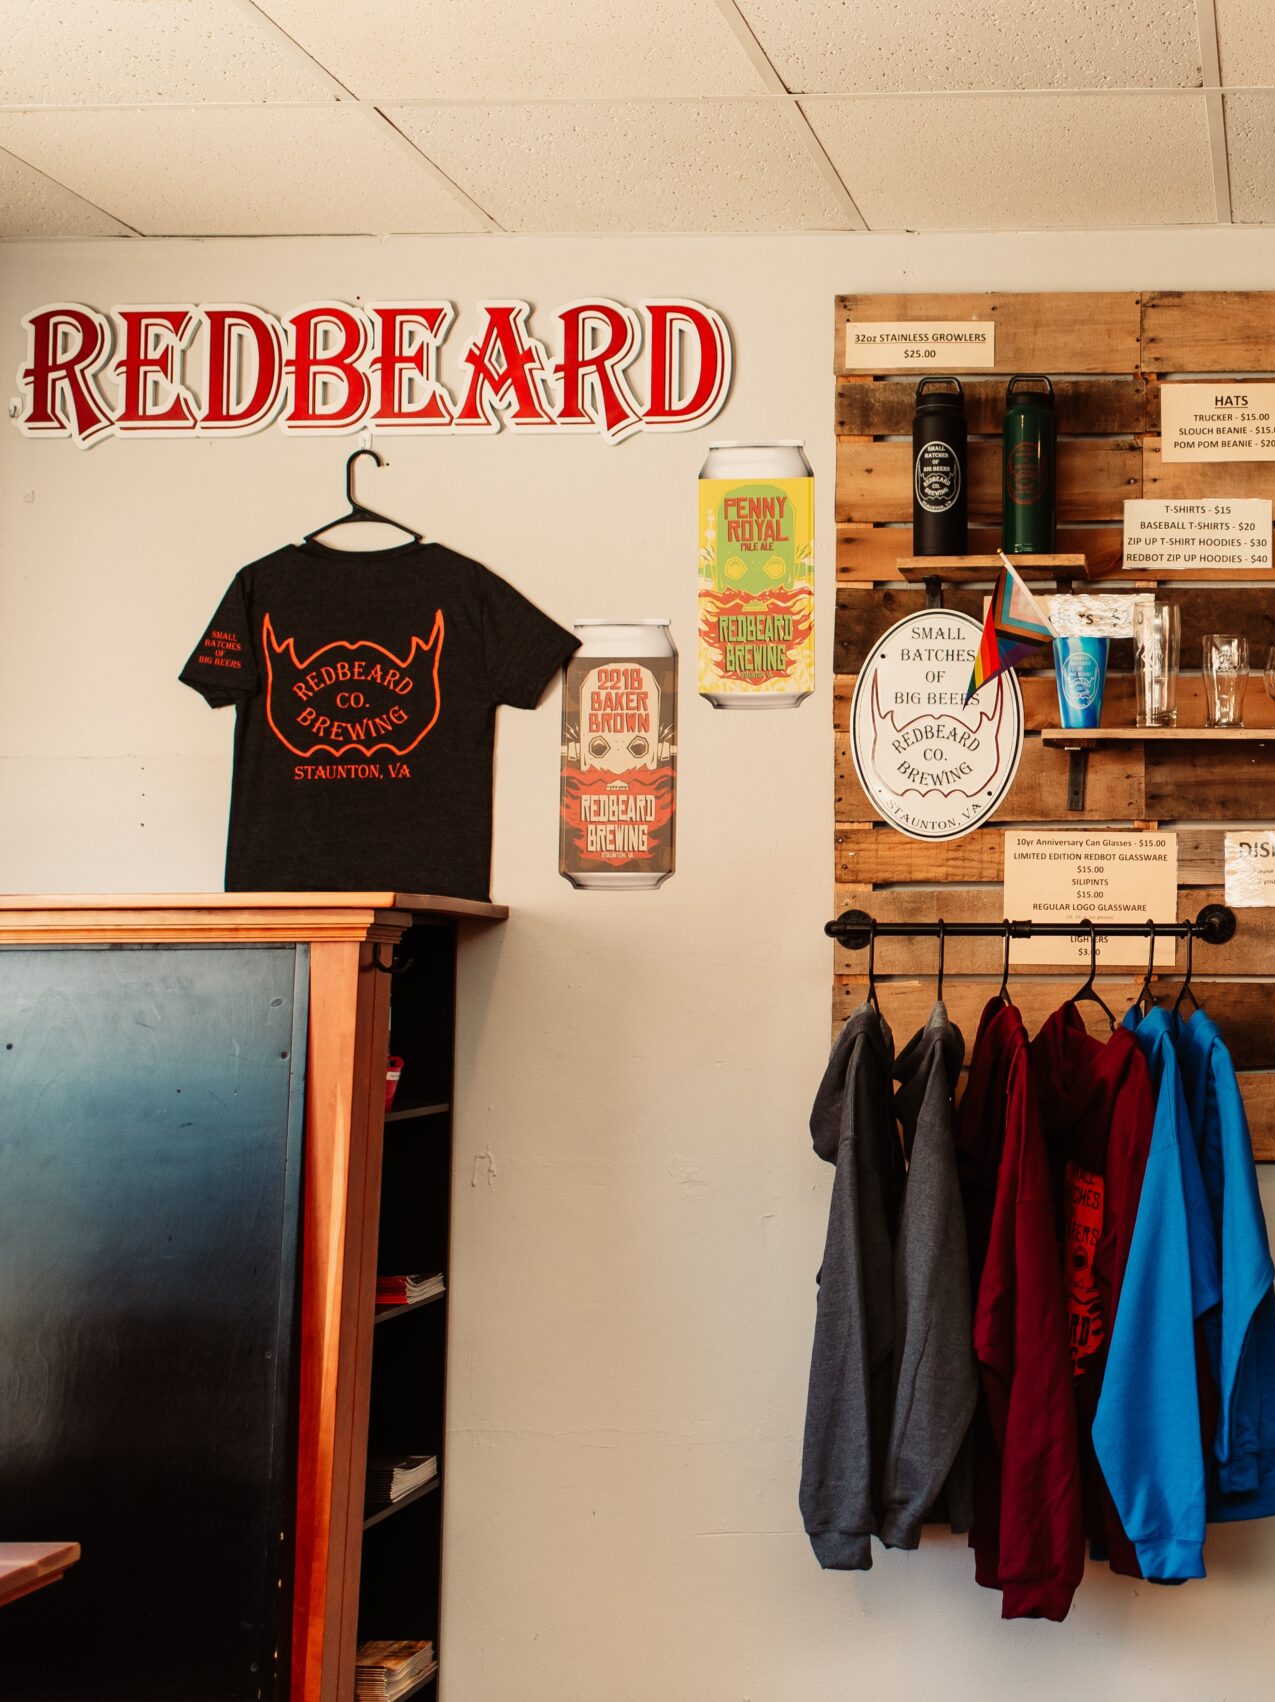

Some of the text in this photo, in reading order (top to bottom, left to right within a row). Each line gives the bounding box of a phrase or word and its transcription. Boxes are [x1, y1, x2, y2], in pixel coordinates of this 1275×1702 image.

[854, 333, 987, 343] 32oz STAINLESS GROWLERS
[904, 349, 936, 359] $25.00
[23, 303, 732, 440] REDBEARD
[1214, 395, 1249, 407] HATS
[1194, 413, 1270, 422] TRUCKER $15.00
[1179, 427, 1214, 436] SLOUCH
[1216, 427, 1248, 435] BEANIE
[1173, 440, 1195, 449] POM
[1197, 440, 1219, 448] POM
[1221, 440, 1253, 448] BEANIE
[724, 495, 788, 520] PENNY
[1165, 505, 1231, 515] T-SHIRTS $15
[727, 518, 789, 543] ROYAL
[1140, 521, 1256, 531] BASEBALL T-SHIRTS $20
[740, 542, 775, 552] PALE ALE
[1127, 537, 1267, 547] ZIP UP T-SHIRT HOODIES $30
[1126, 553, 1268, 564] REDBOT ZIP UP HOODIES $40
[717, 614, 794, 643] REDBEARD
[911, 627, 965, 640] SMALL
[211, 631, 237, 641] SMALL
[204, 638, 241, 650] BATCHES
[215, 649, 225, 657] OF
[725, 644, 786, 672] BREWING
[900, 648, 976, 662] BATCHES
[198, 655, 242, 669] BIG BEERS
[292, 661, 414, 701] REDBEARD
[597, 668, 643, 690] 221B
[925, 670, 946, 683] OF
[336, 692, 370, 709] CO.
[590, 691, 649, 712] BAKER
[894, 692, 921, 705] BIG
[296, 705, 409, 741] BREWING
[588, 712, 650, 734] BROWN
[891, 724, 980, 754] REDBEARD
[923, 748, 948, 761] CO.
[294, 763, 411, 780] STAUNTON, VA
[897, 760, 973, 787] BREWING
[580, 794, 656, 822] REDBEARD
[886, 799, 981, 831] STAUNTON, VA
[586, 824, 649, 852] BREWING
[1016, 838, 1166, 848] 10yr Anniversary Can Glasses $15.00
[1013, 852, 1047, 860] LIMITED
[1084, 853, 1116, 861] REDBOT
[1118, 853, 1168, 861] GLASSWARE
[1077, 865, 1104, 873] $15.00
[1072, 878, 1109, 886] SILIPINTS
[1076, 891, 1104, 899] $15.00
[1033, 903, 1070, 911] REGULAR
[1072, 903, 1096, 911] LOGO
[1078, 948, 1101, 956] $3.0
